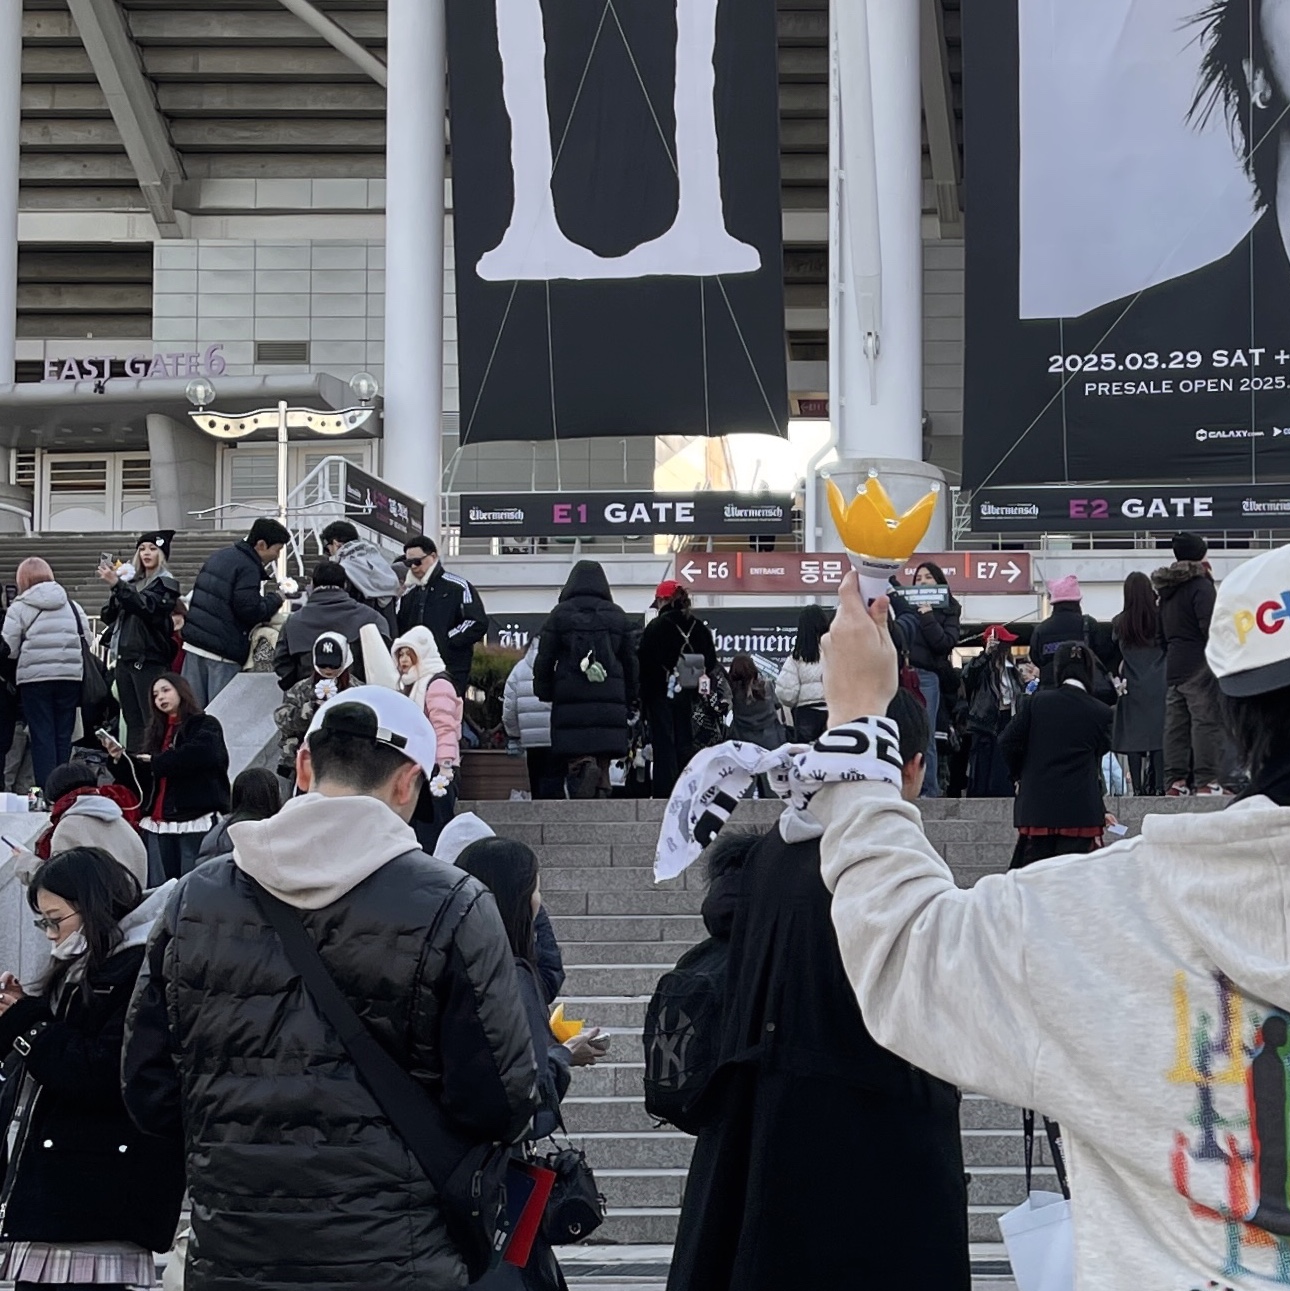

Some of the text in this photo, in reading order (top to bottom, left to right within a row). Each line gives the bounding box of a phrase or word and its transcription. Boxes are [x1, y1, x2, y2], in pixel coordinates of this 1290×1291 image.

[44, 355, 117, 382] EAST
[1048, 351, 1202, 373] 2025.03.29
[1212, 347, 1266, 368] SAT
[1084, 379, 1174, 397] PRESALE
[1179, 377, 1234, 394] OPEN
[469, 505, 524, 521] Übermensch
[553, 501, 695, 524] E1 GATE
[723, 503, 783, 518] Übermensch
[980, 501, 1039, 516] Übermensch
[1069, 496, 1214, 519] E2 GATE
[707, 561, 729, 579] E6
[750, 567, 785, 575] ENTRANCE
[800, 560, 843, 584] 동문
[977, 561, 998, 580] E7
